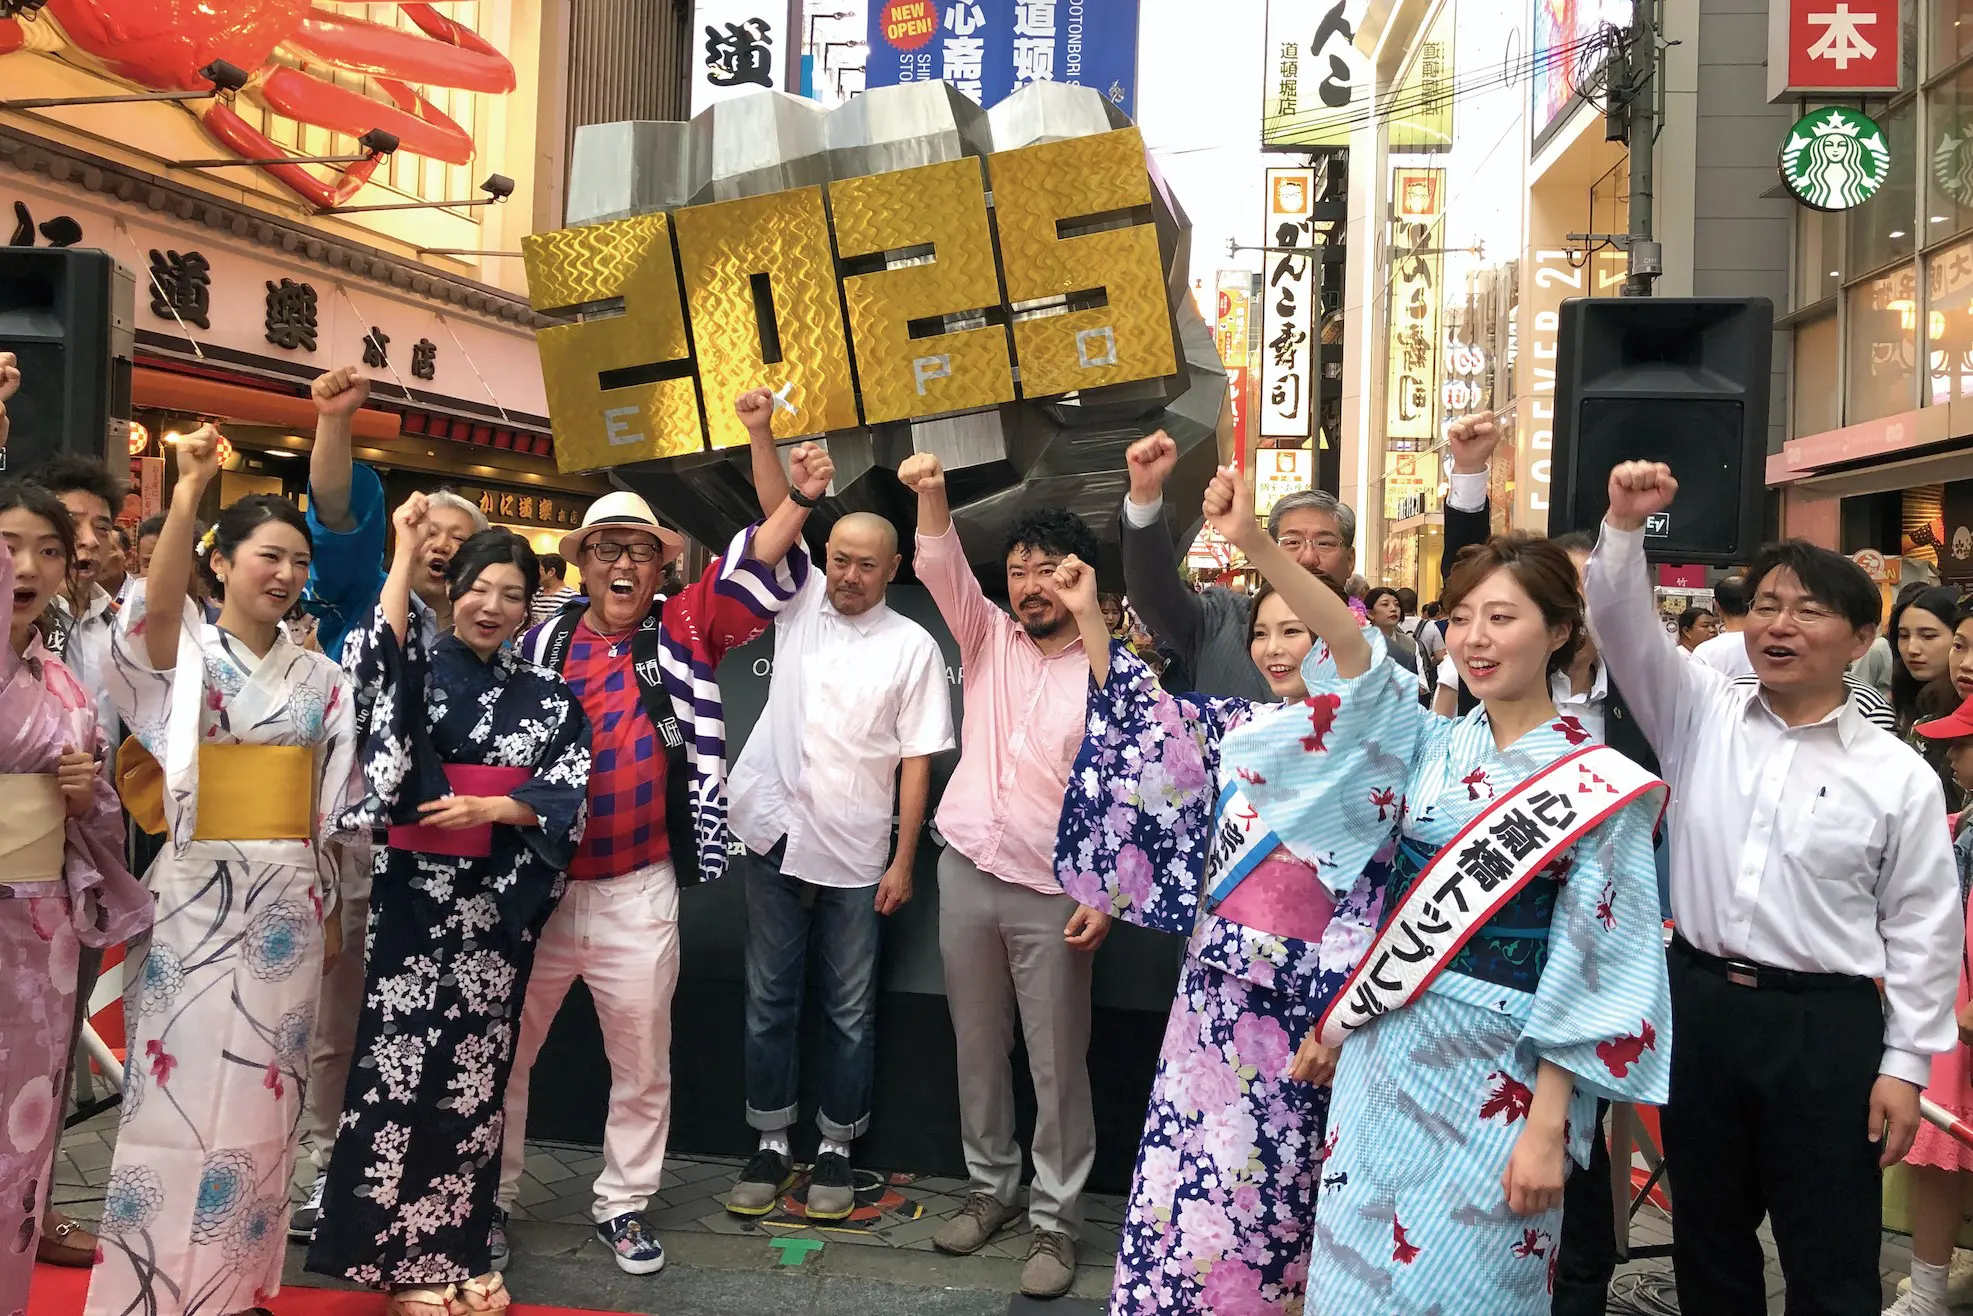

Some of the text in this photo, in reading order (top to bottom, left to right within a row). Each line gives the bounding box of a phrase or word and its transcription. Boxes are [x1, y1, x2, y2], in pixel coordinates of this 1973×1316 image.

[888, 17, 933, 40] OPEN!
[891, 2, 925, 21] NEW
[1806, 3, 1878, 70] 本
[898, 54, 914, 85] STO
[1011, 0, 1056, 94] 道顿
[1278, 42, 1299, 116] 道頓堀店
[1535, 250, 1582, 289] 21
[521, 126, 1178, 475] 2025
